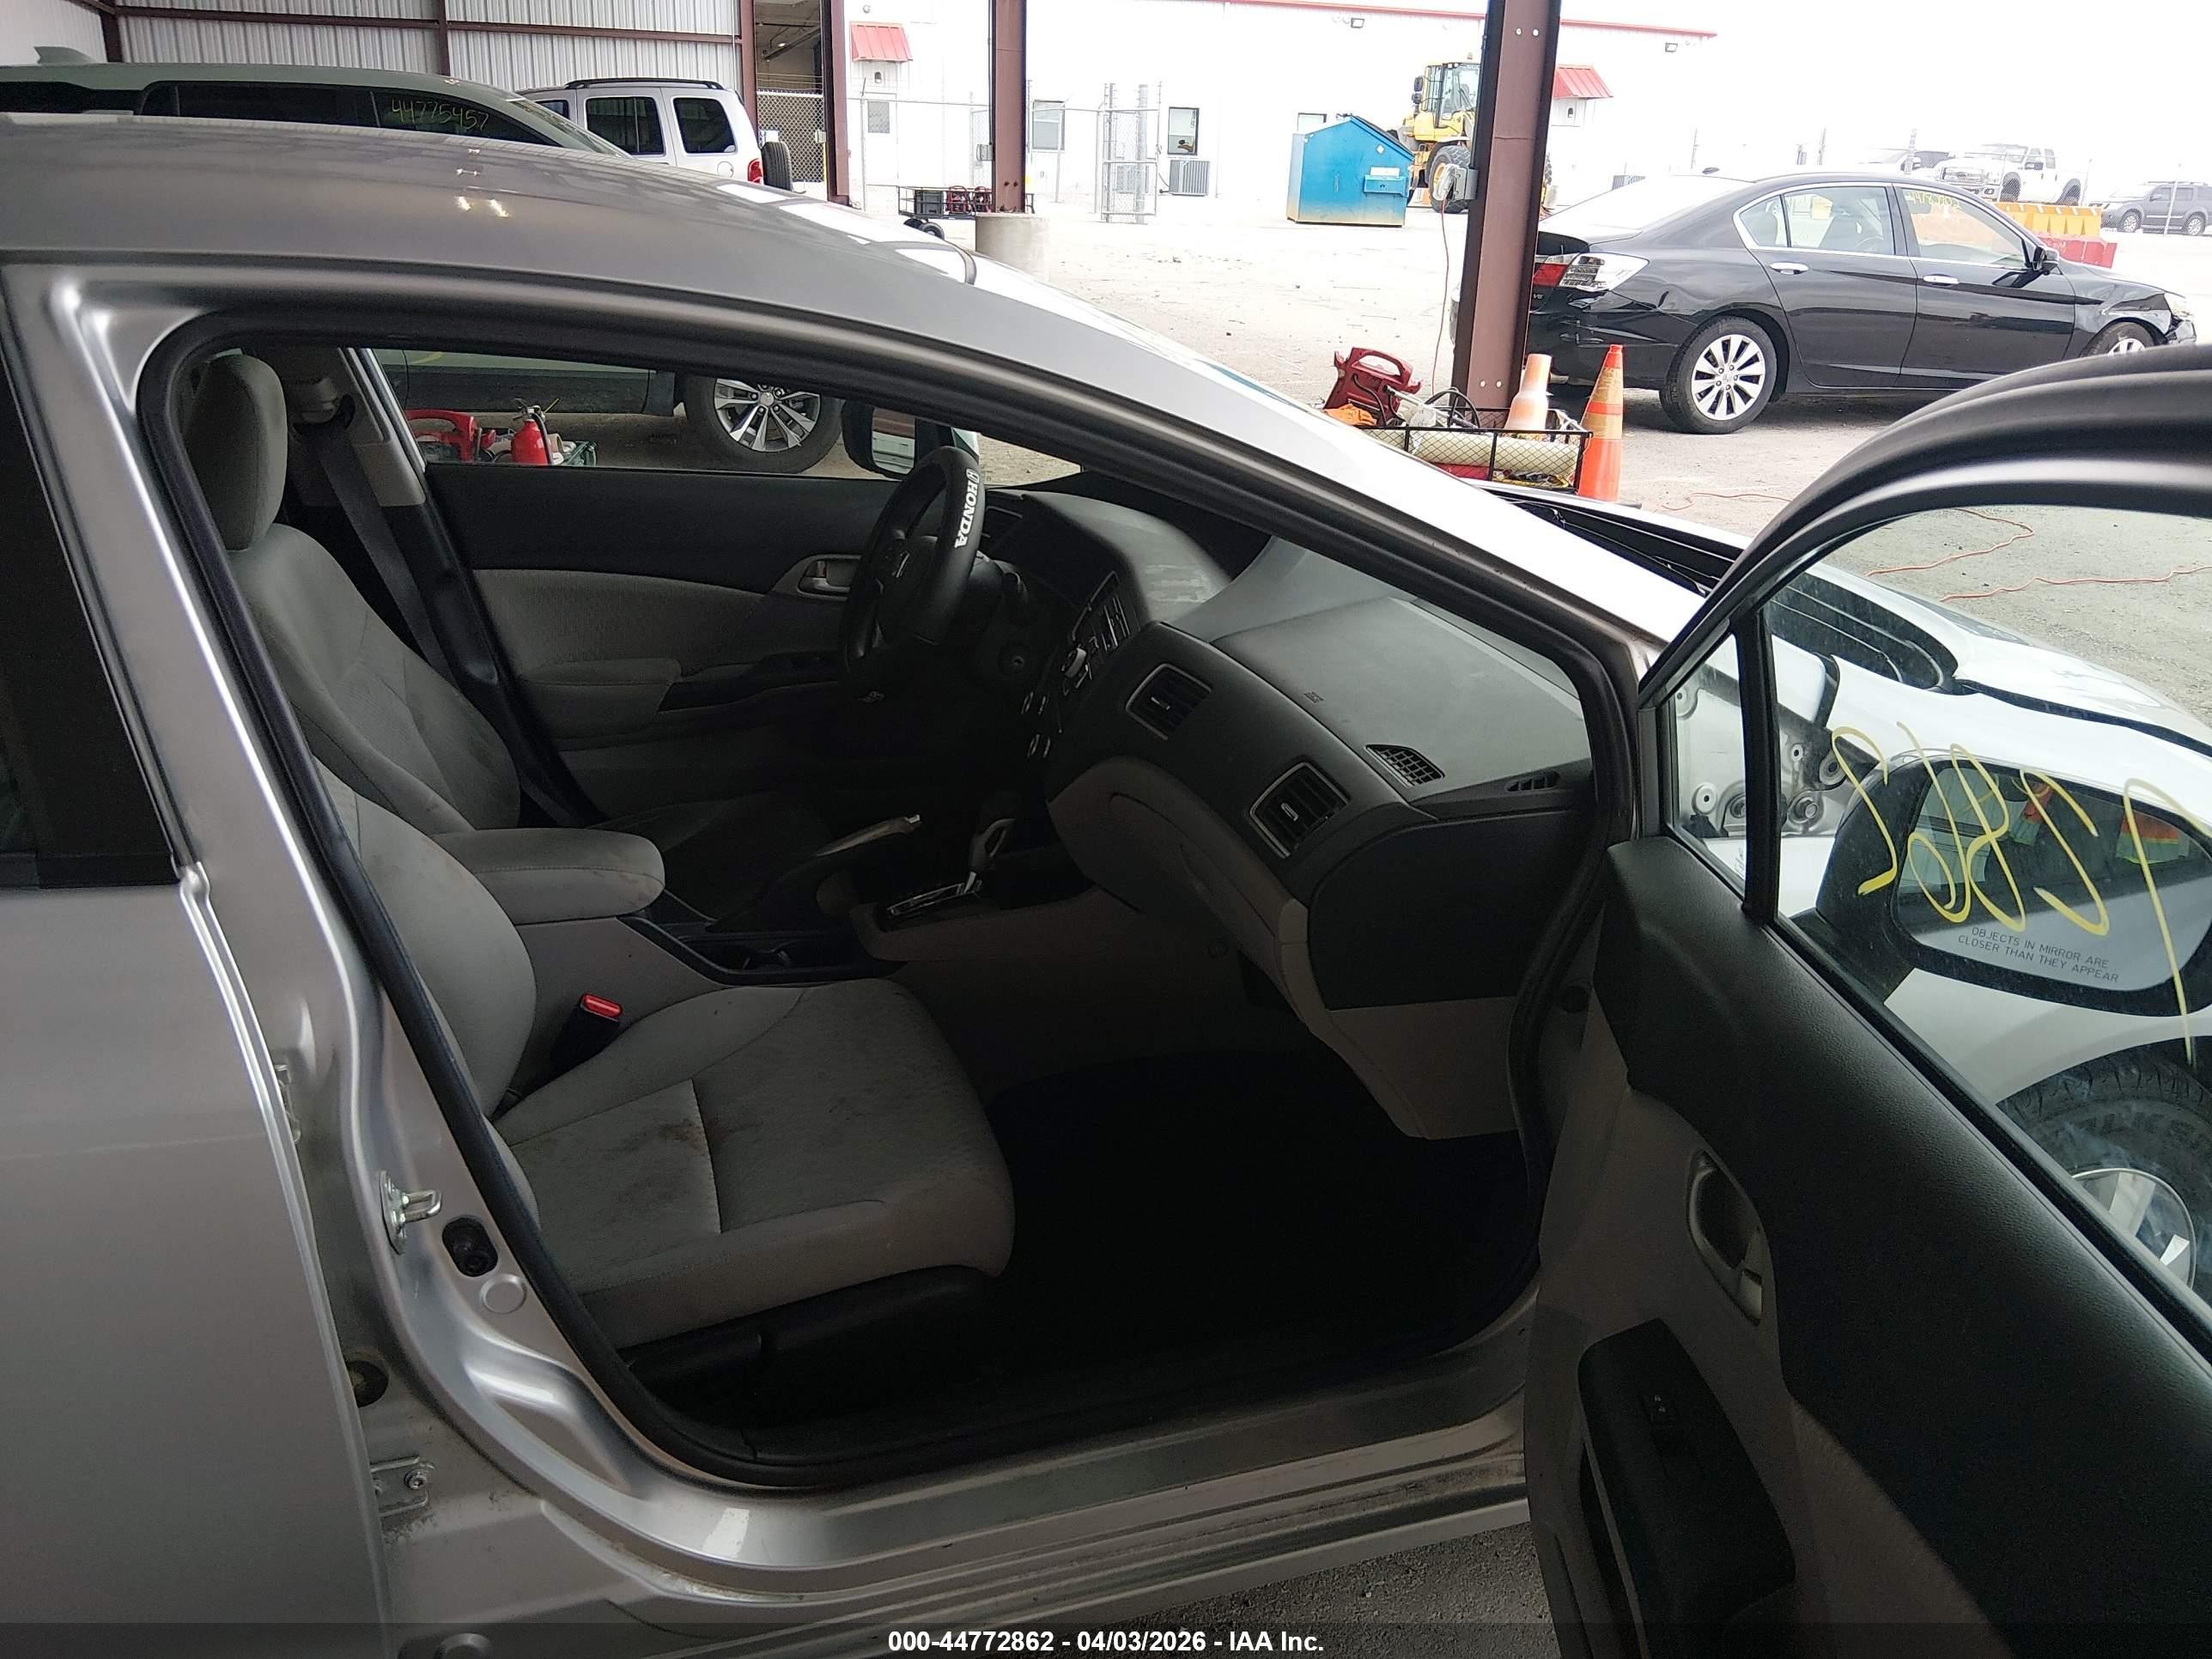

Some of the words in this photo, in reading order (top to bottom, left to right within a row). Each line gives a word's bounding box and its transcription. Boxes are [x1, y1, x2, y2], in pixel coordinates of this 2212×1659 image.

[392, 97, 489, 131] 44775457
[954, 480, 978, 549] HONDA
[1958, 934, 2000, 953] CLOSER
[2005, 946, 2035, 962] THAN
[2039, 954, 2067, 969] THEY
[2071, 964, 2119, 983] APPEAR
[1972, 927, 2020, 946] OBJECTS
[2024, 940, 2035, 950] IN
[2039, 944, 2081, 963] MIRROR
[2086, 955, 2110, 969] ARE
